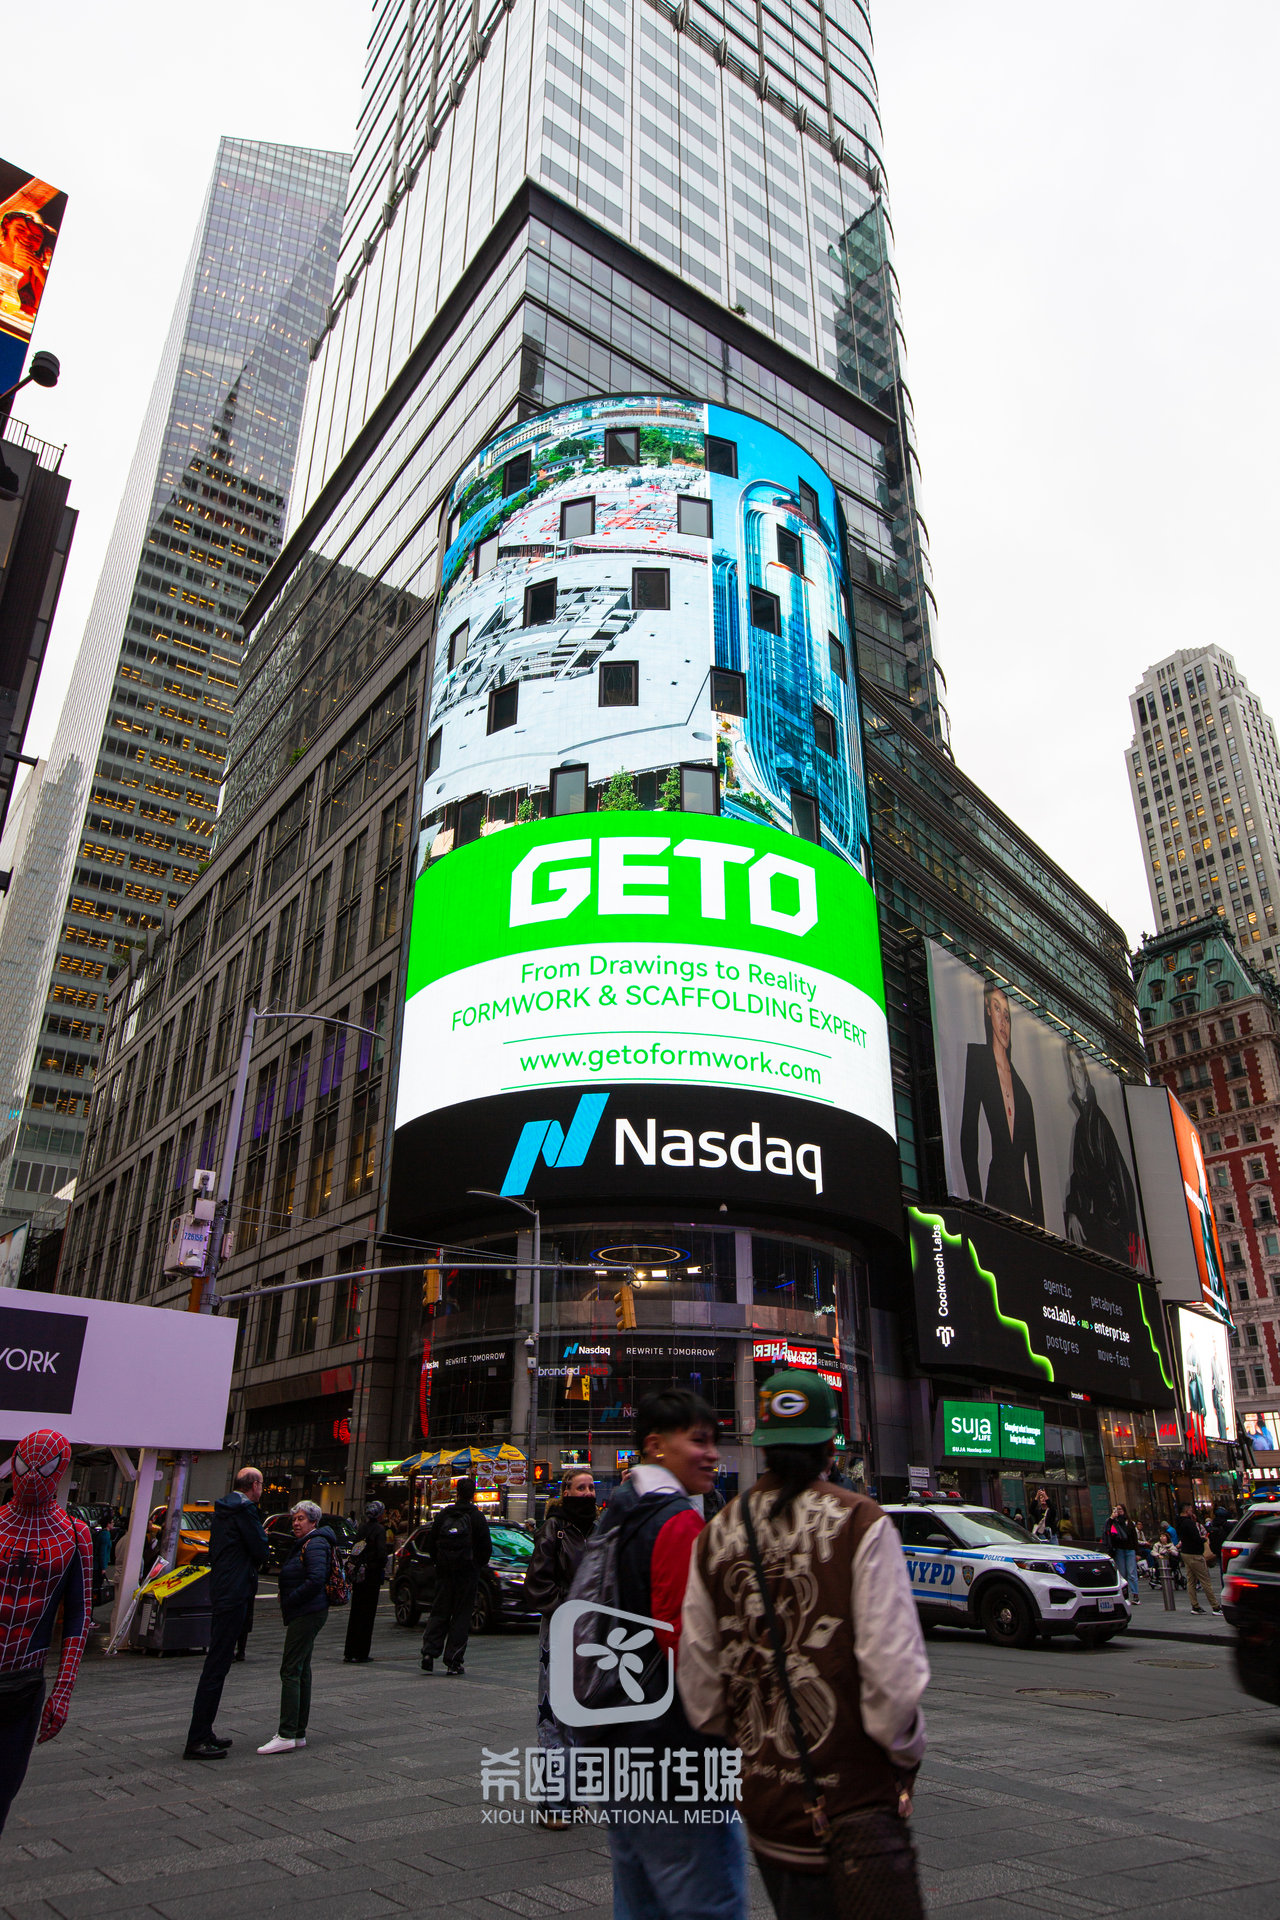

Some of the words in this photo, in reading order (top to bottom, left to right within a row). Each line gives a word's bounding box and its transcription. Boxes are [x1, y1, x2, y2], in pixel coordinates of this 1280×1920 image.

[509, 837, 818, 937] GETO
[521, 963, 580, 983] From
[590, 955, 708, 982] Drawings
[715, 961, 740, 980] to
[749, 963, 816, 1002] Reality
[452, 987, 591, 1031] FORMWORK
[598, 984, 618, 1006] &
[626, 984, 803, 1023] SCAFFOLDING
[809, 1008, 867, 1048] EXPERT
[520, 1042, 821, 1084] www.getoformwork.com
[615, 1118, 823, 1195] Nasdaq
[932, 1224, 942, 1252] Labs
[934, 1253, 948, 1317] Cockroach
[1043, 1279, 1072, 1299] agentic
[1090, 1296, 1123, 1316] petabytes
[1042, 1305, 1076, 1326] scalable
[1094, 1322, 1130, 1343] enterprise
[578, 1345, 611, 1355] Nasdaq
[626, 1347, 664, 1355] REWRITE
[668, 1347, 716, 1356] TOMORROW
[1045, 1335, 1080, 1354] postgres
[445, 1356, 467, 1366] REWRITE
[469, 1352, 505, 1363] TOMORROW
[1097, 1349, 1131, 1368] move-fast
[538, 1365, 608, 1376] brandedcities
[951, 1417, 992, 1441] suja
[978, 1434, 991, 1442] LIFE
[983, 1553, 1005, 1562] POLICE
